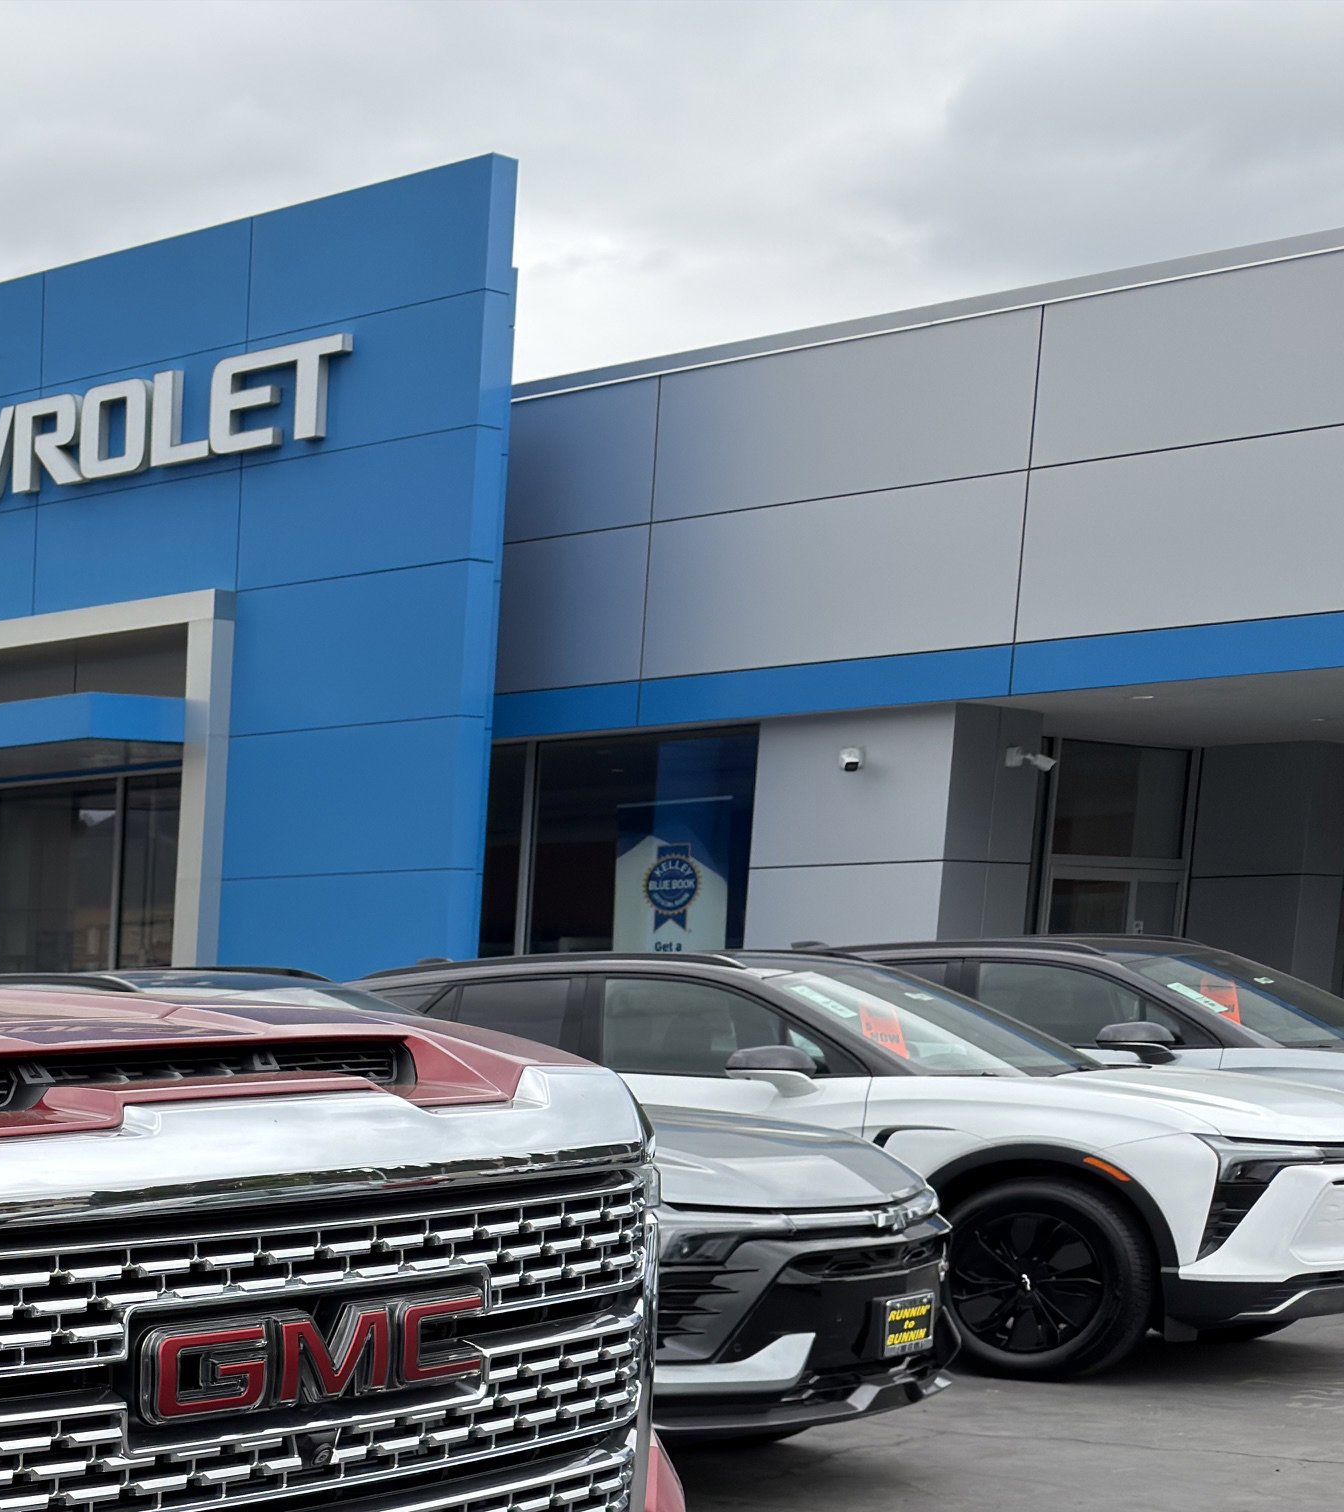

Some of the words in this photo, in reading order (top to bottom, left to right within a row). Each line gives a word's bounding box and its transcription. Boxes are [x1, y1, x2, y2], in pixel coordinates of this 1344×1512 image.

[654, 860, 694, 877] KELLEY
[648, 879, 671, 891] BLUE
[671, 878, 696, 890] BOOK
[654, 941, 673, 952] Get
[675, 942, 683, 952] a
[904, 1320, 915, 1329] to
[886, 1328, 927, 1346] BUNNIN
[143, 1287, 483, 1423] GMC
